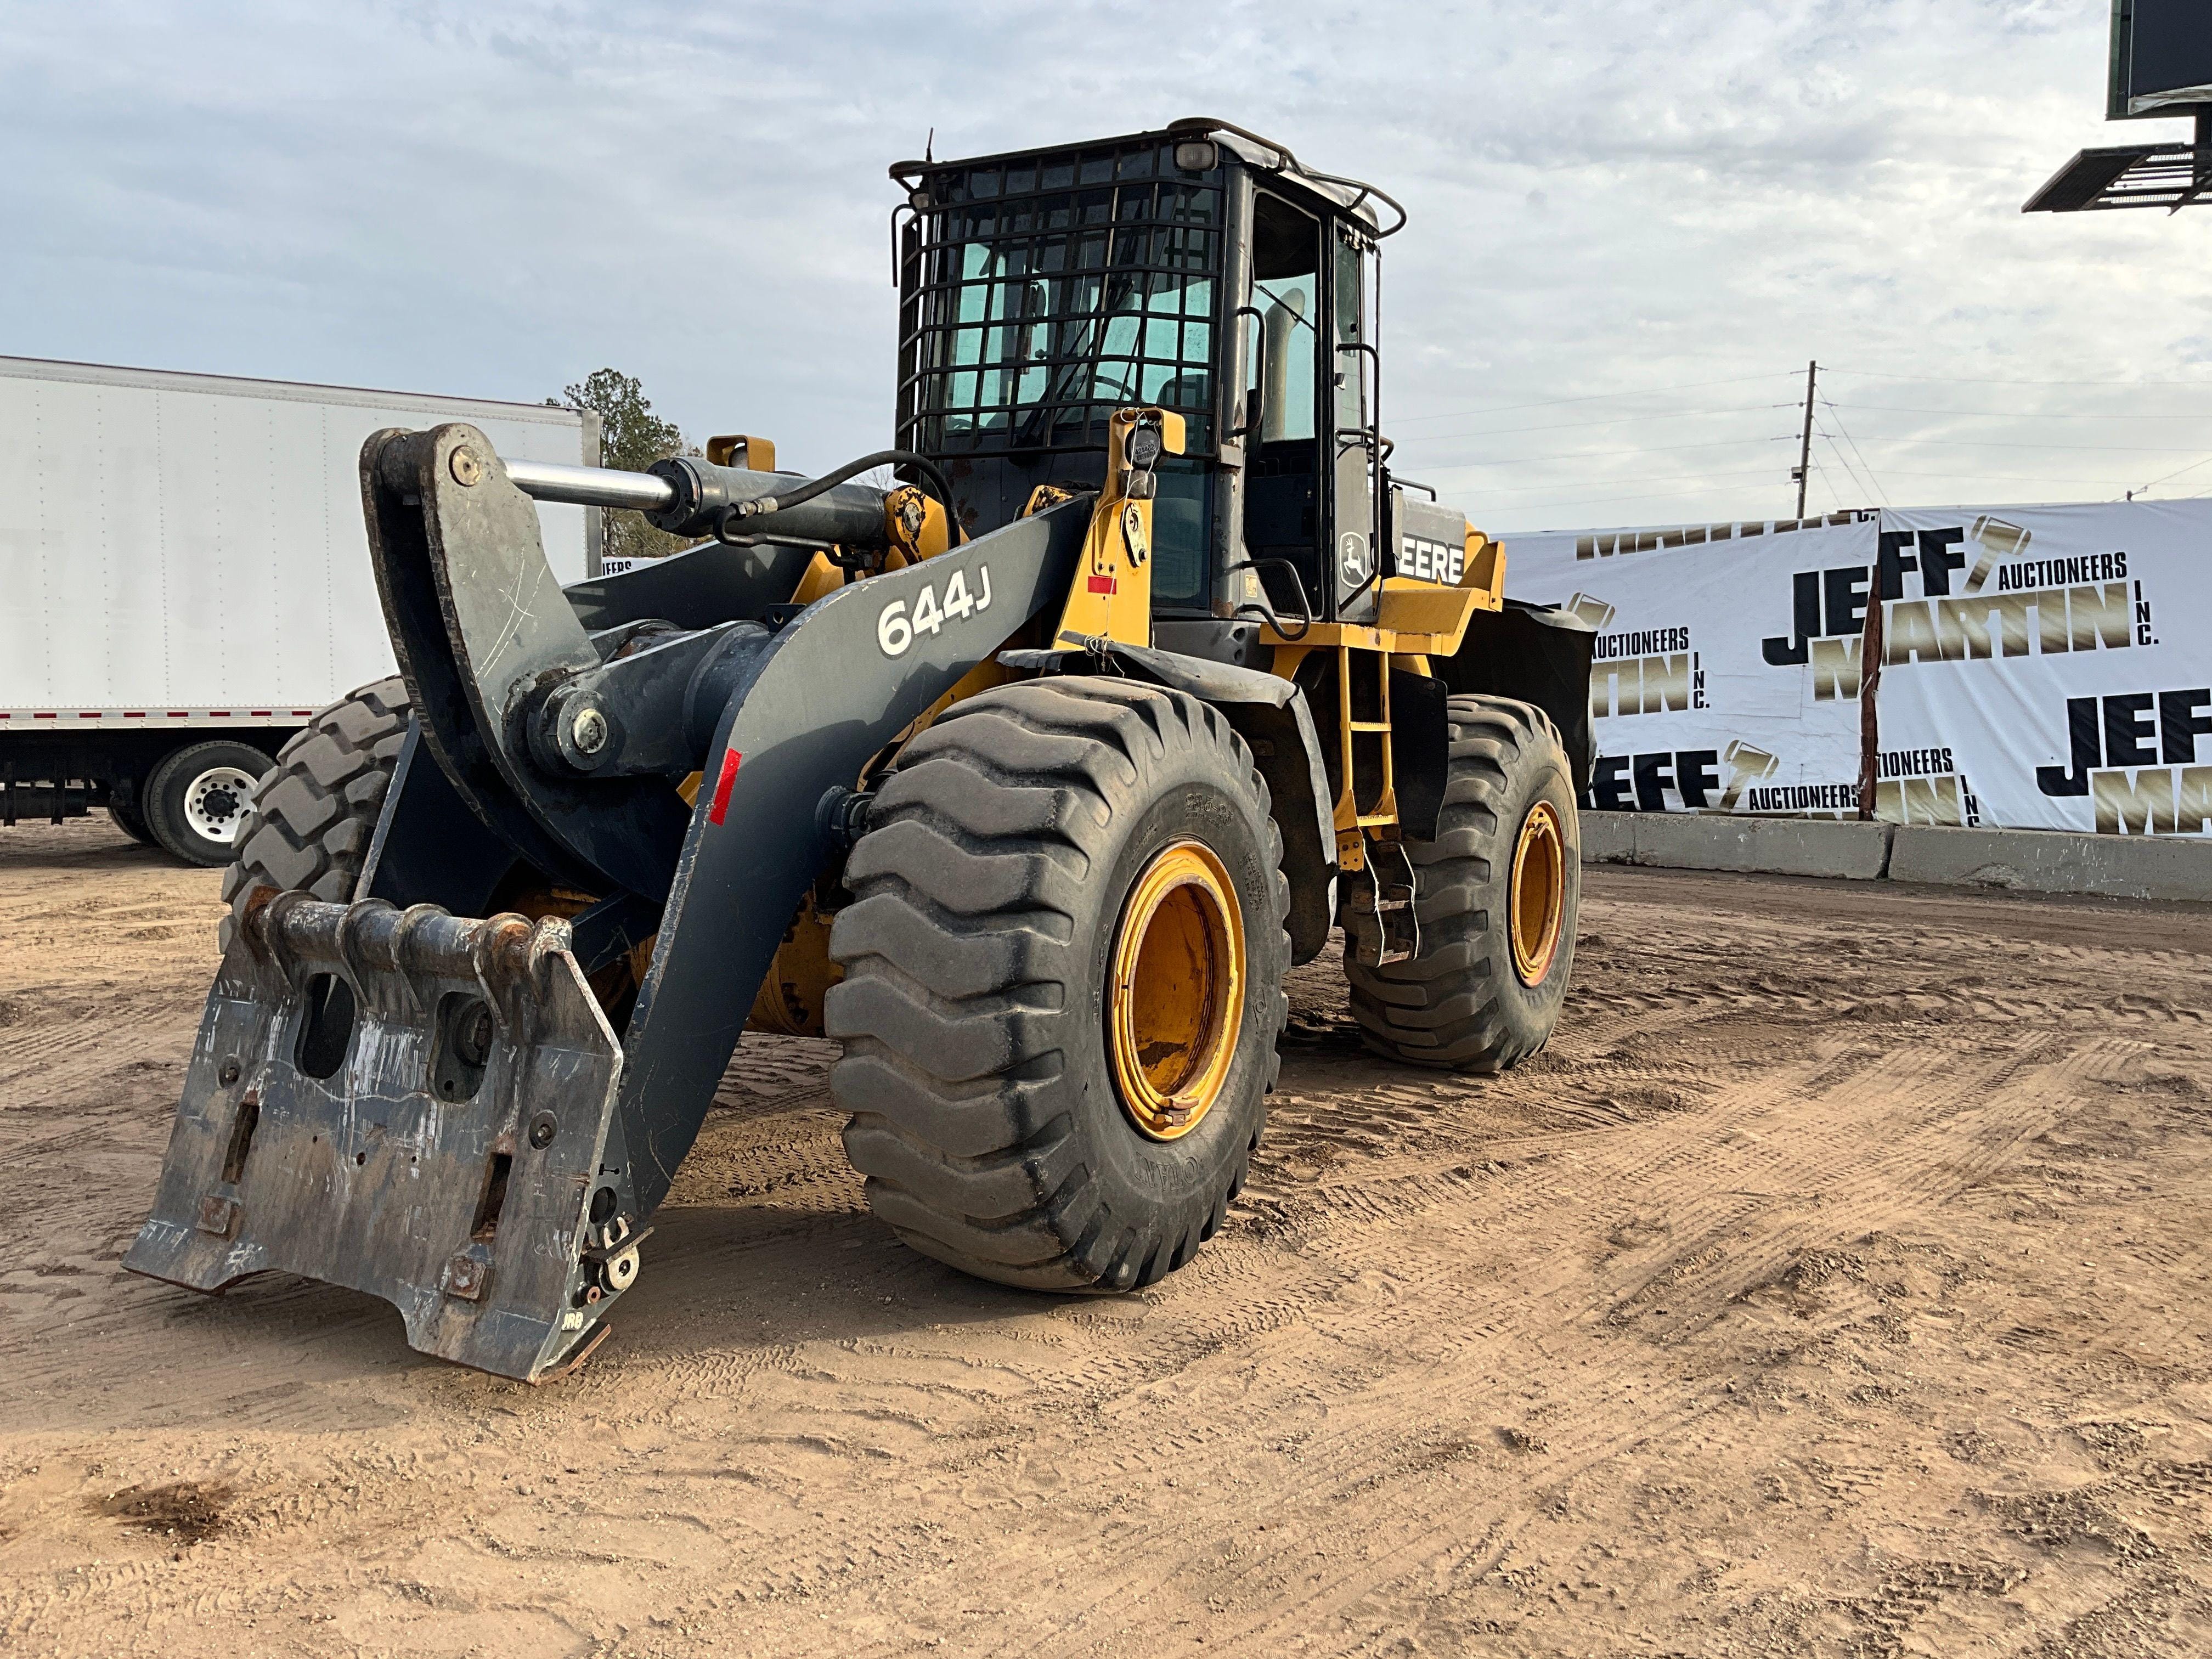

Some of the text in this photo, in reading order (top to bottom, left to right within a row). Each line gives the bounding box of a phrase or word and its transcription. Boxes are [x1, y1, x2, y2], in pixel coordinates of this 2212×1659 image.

[1762, 527, 1966, 665] JEFF
[1999, 552, 2127, 591] AUCTIONEERS
[878, 566, 992, 656] 644J
[1812, 582, 2131, 701] MARTIN
[2135, 580, 2159, 645] INC.
[1694, 652, 1710, 709] INC.
[1749, 785, 1860, 811] AUCTIONEERS
[561, 1312, 583, 1330] JRB
